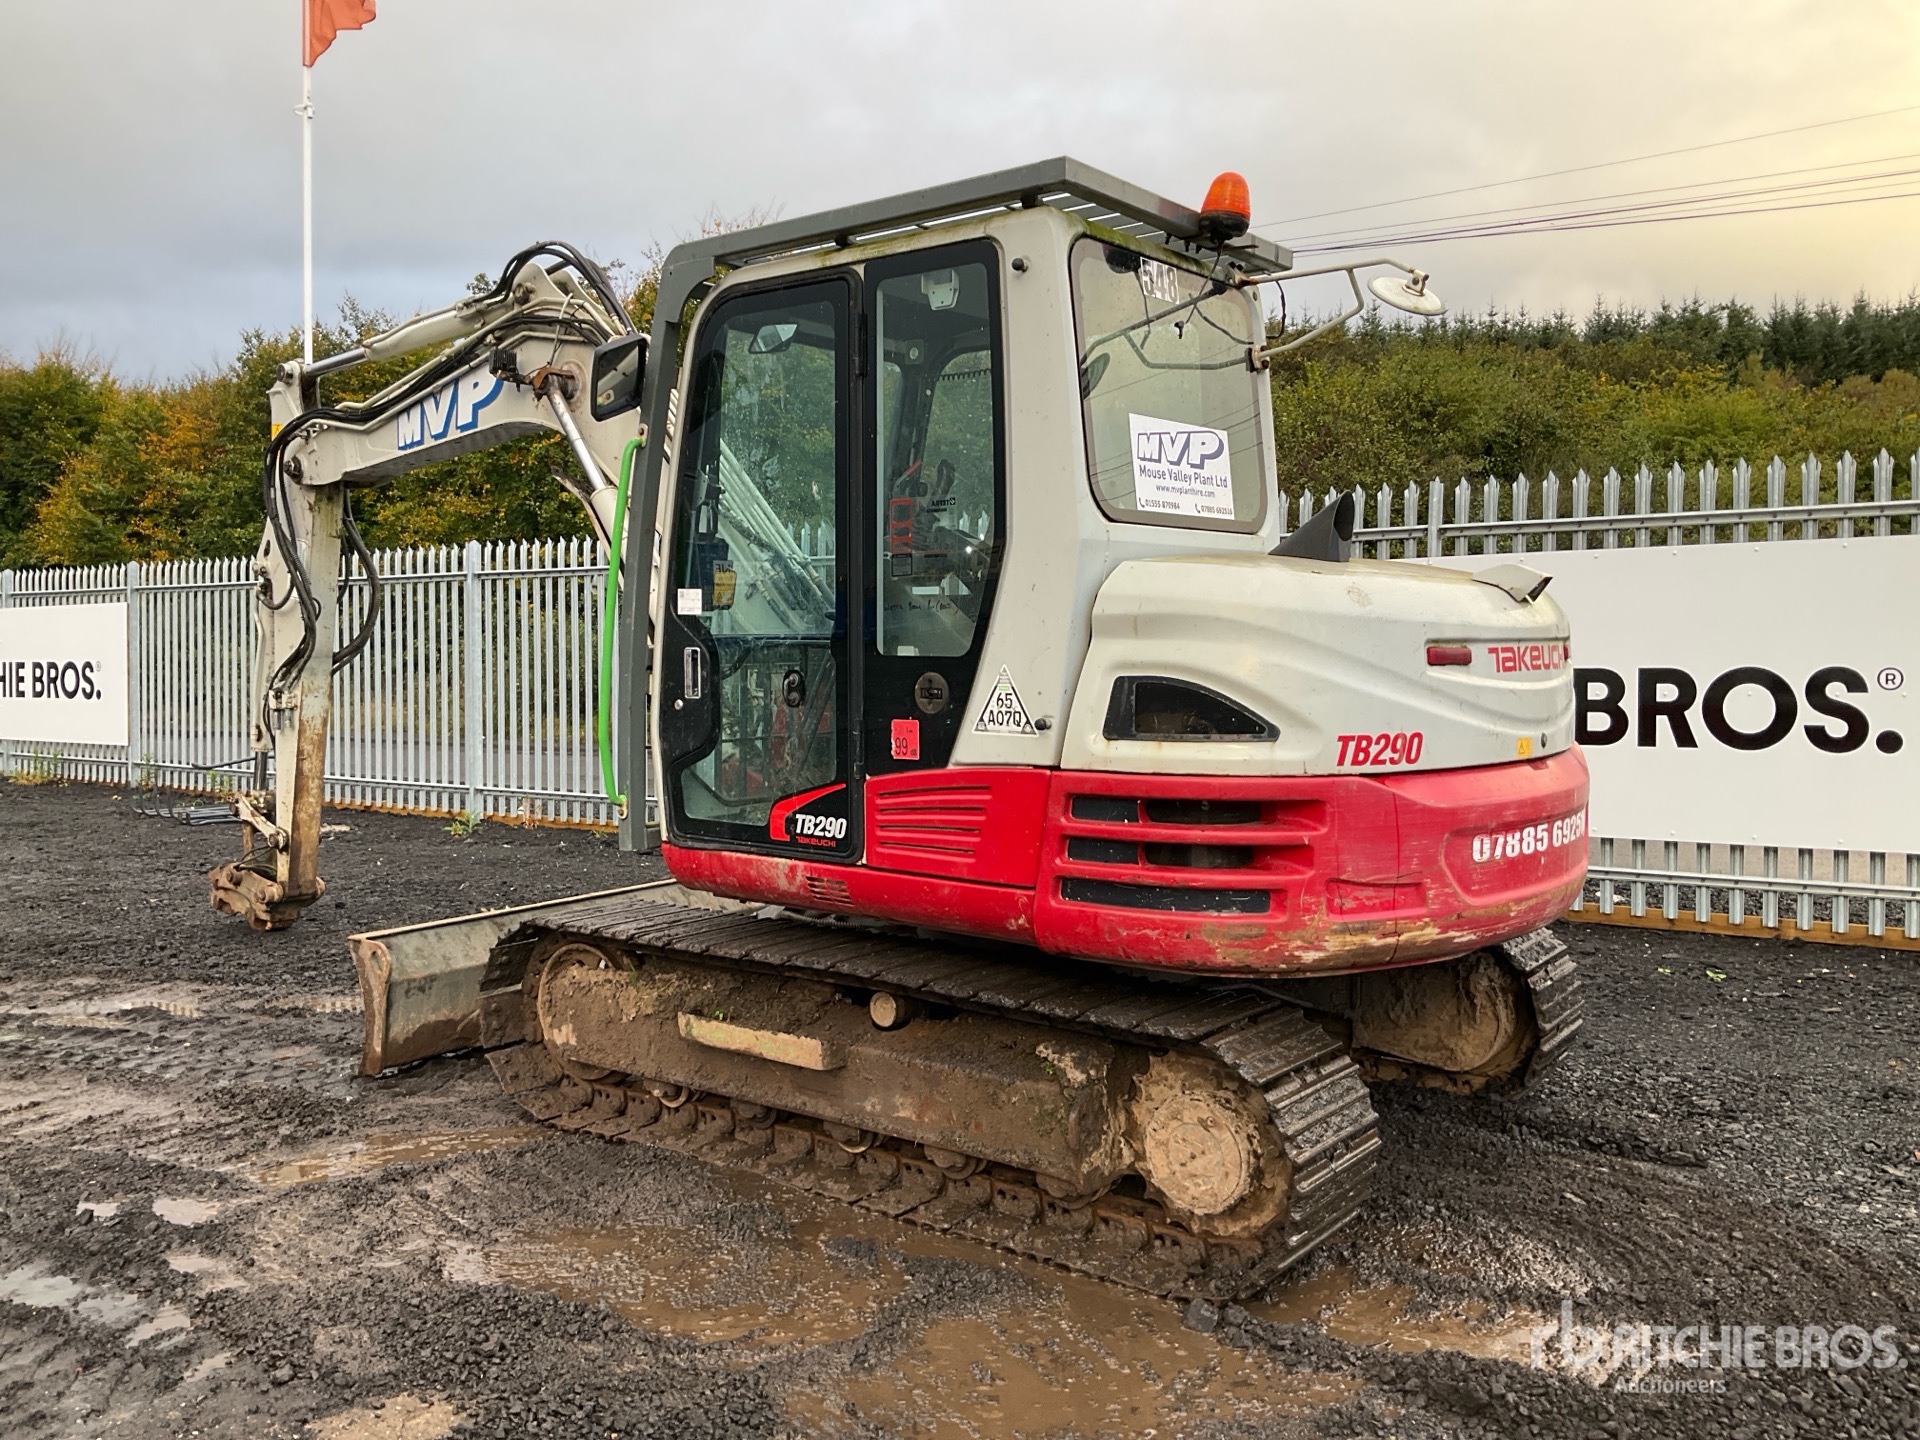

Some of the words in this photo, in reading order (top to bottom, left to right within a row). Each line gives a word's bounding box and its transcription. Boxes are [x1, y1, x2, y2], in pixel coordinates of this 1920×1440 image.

[397, 363, 504, 450] MVP
[1137, 430, 1225, 470] MVP
[1139, 464, 1166, 480] Mouse
[1167, 468, 1192, 486] Valley
[1193, 472, 1214, 487] Plant
[1215, 475, 1228, 489] Ltd
[996, 692, 1013, 709] 65
[895, 736, 908, 756] 99
[1336, 731, 1424, 767] TB290
[795, 813, 847, 839] TB290
[795, 835, 836, 848] TAKEUCHI
[1472, 823, 1549, 863] 07885
